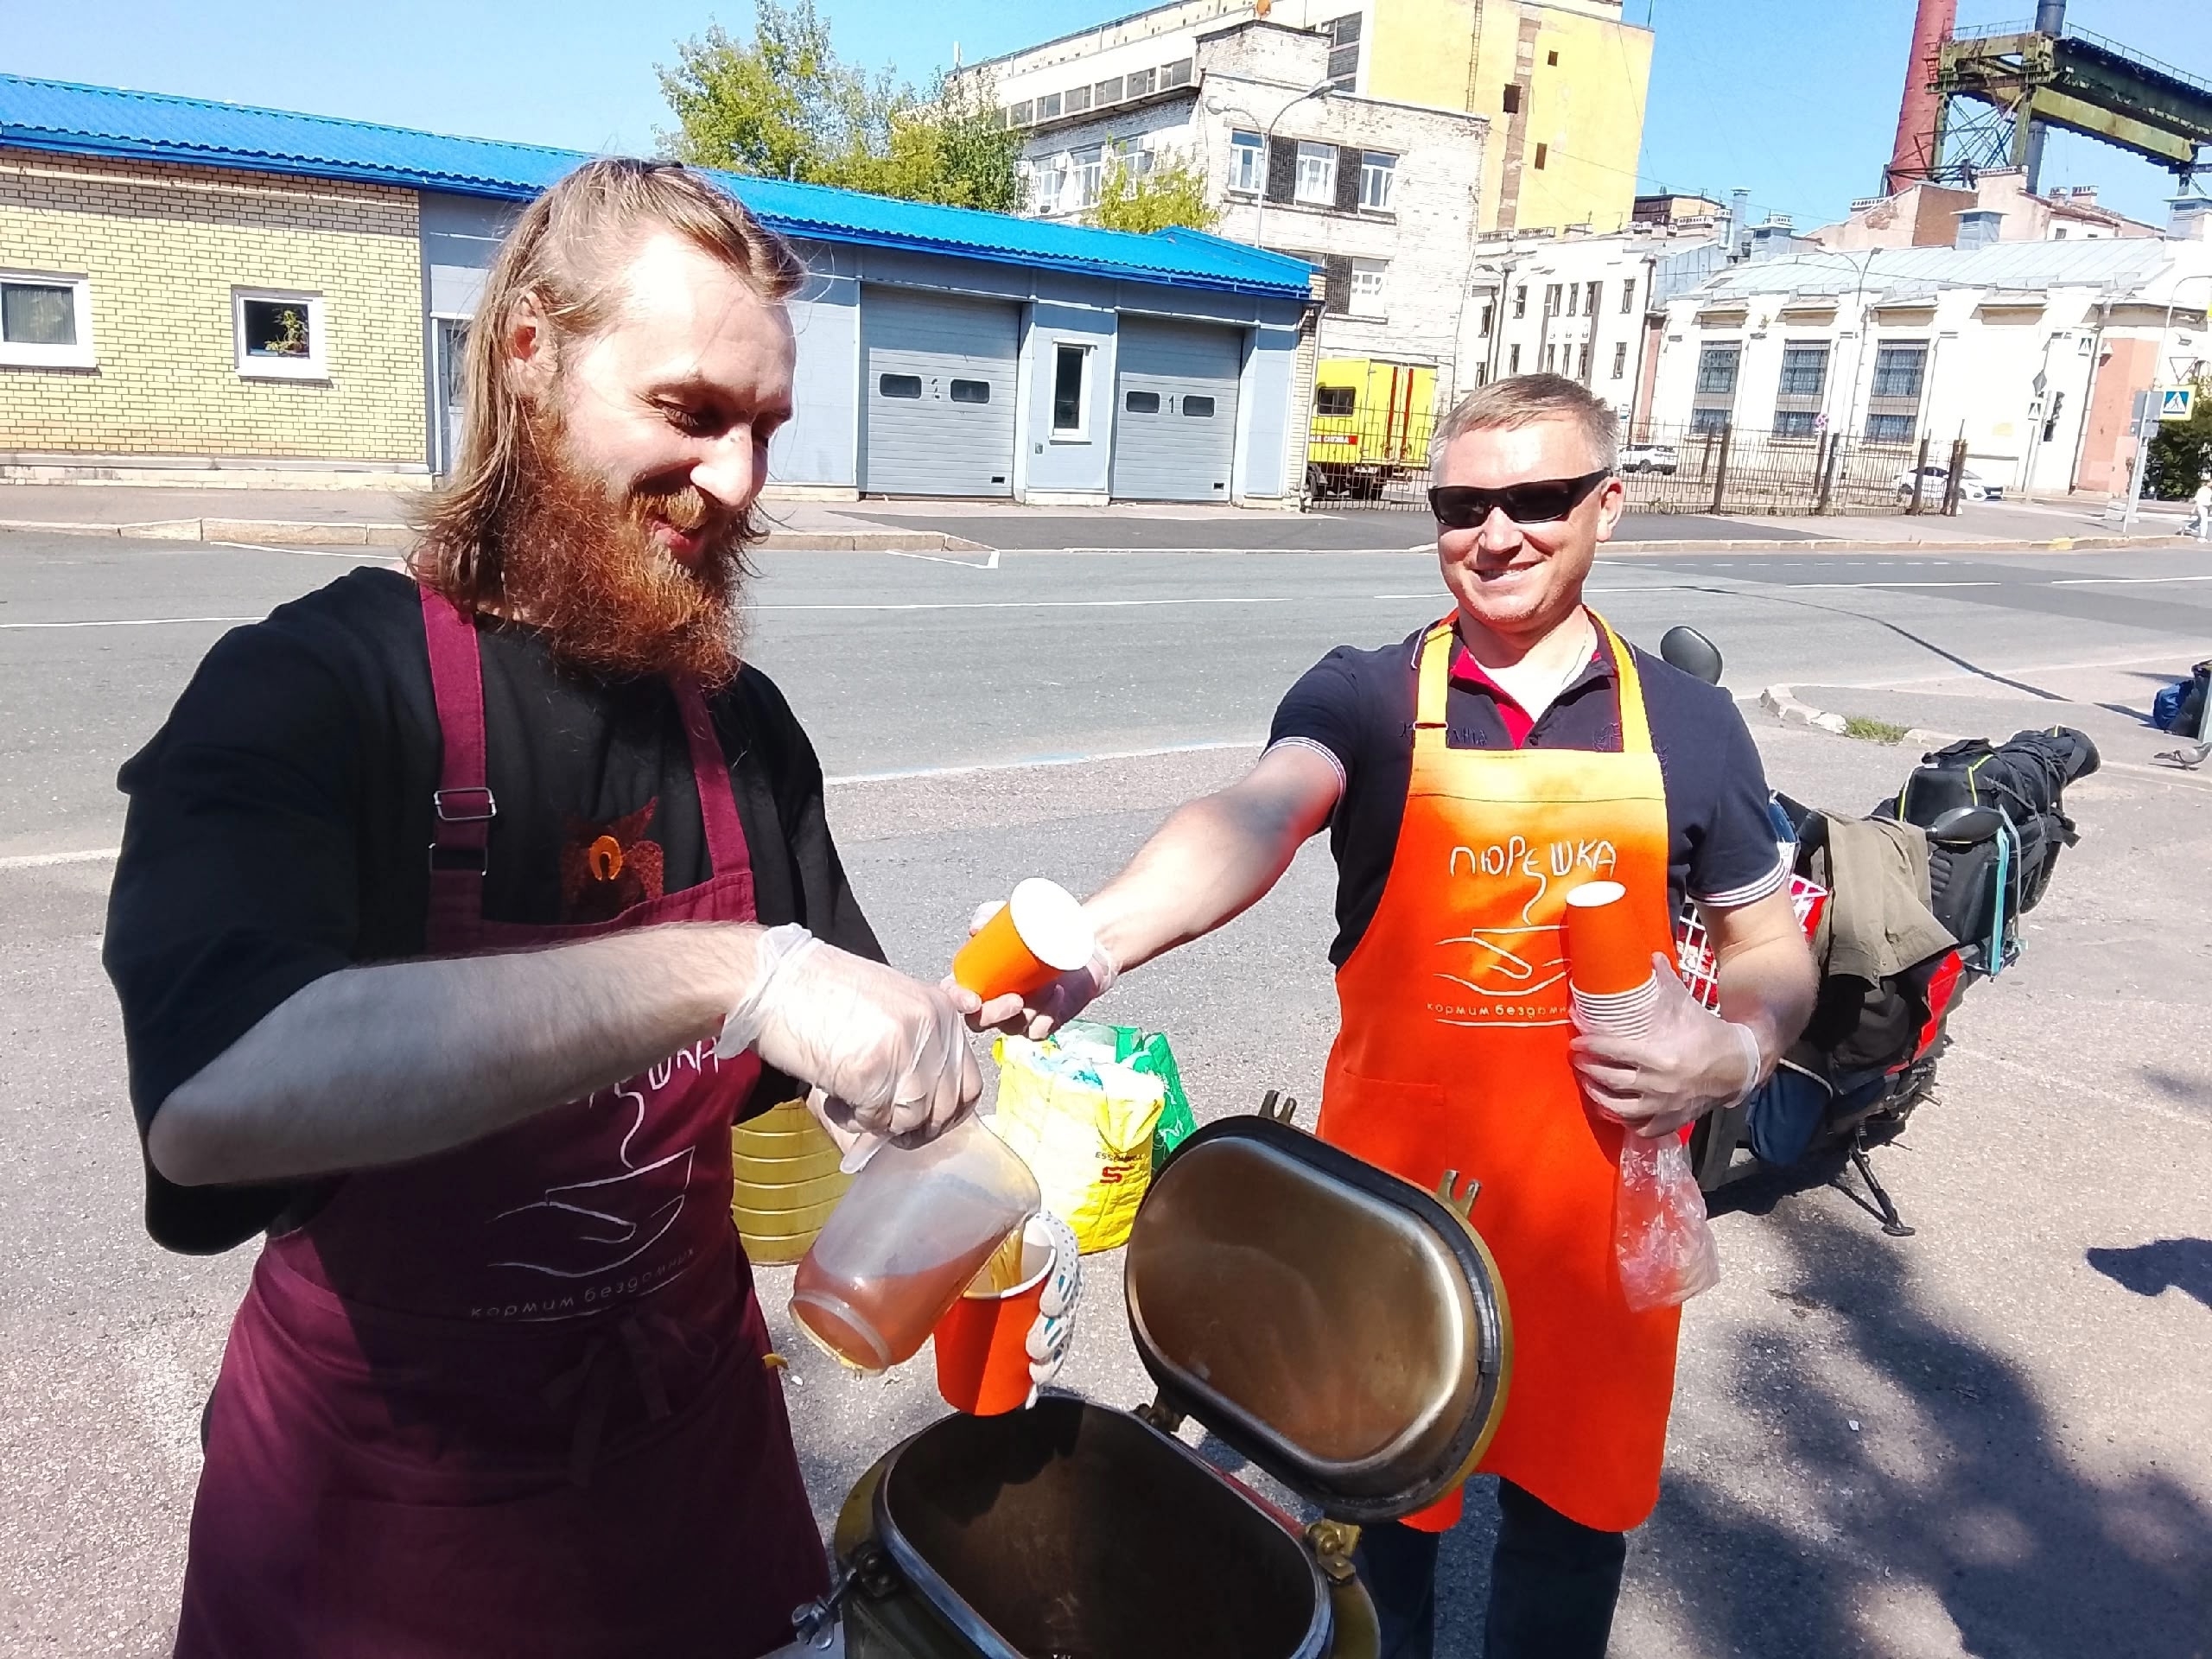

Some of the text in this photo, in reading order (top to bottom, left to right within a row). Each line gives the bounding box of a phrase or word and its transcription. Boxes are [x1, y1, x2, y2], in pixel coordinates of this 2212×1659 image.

[1168, 394, 1174, 414] 1
[1427, 1002, 1567, 1019] кормим бездомн
[470, 1249, 695, 1319] кормим бездомных
